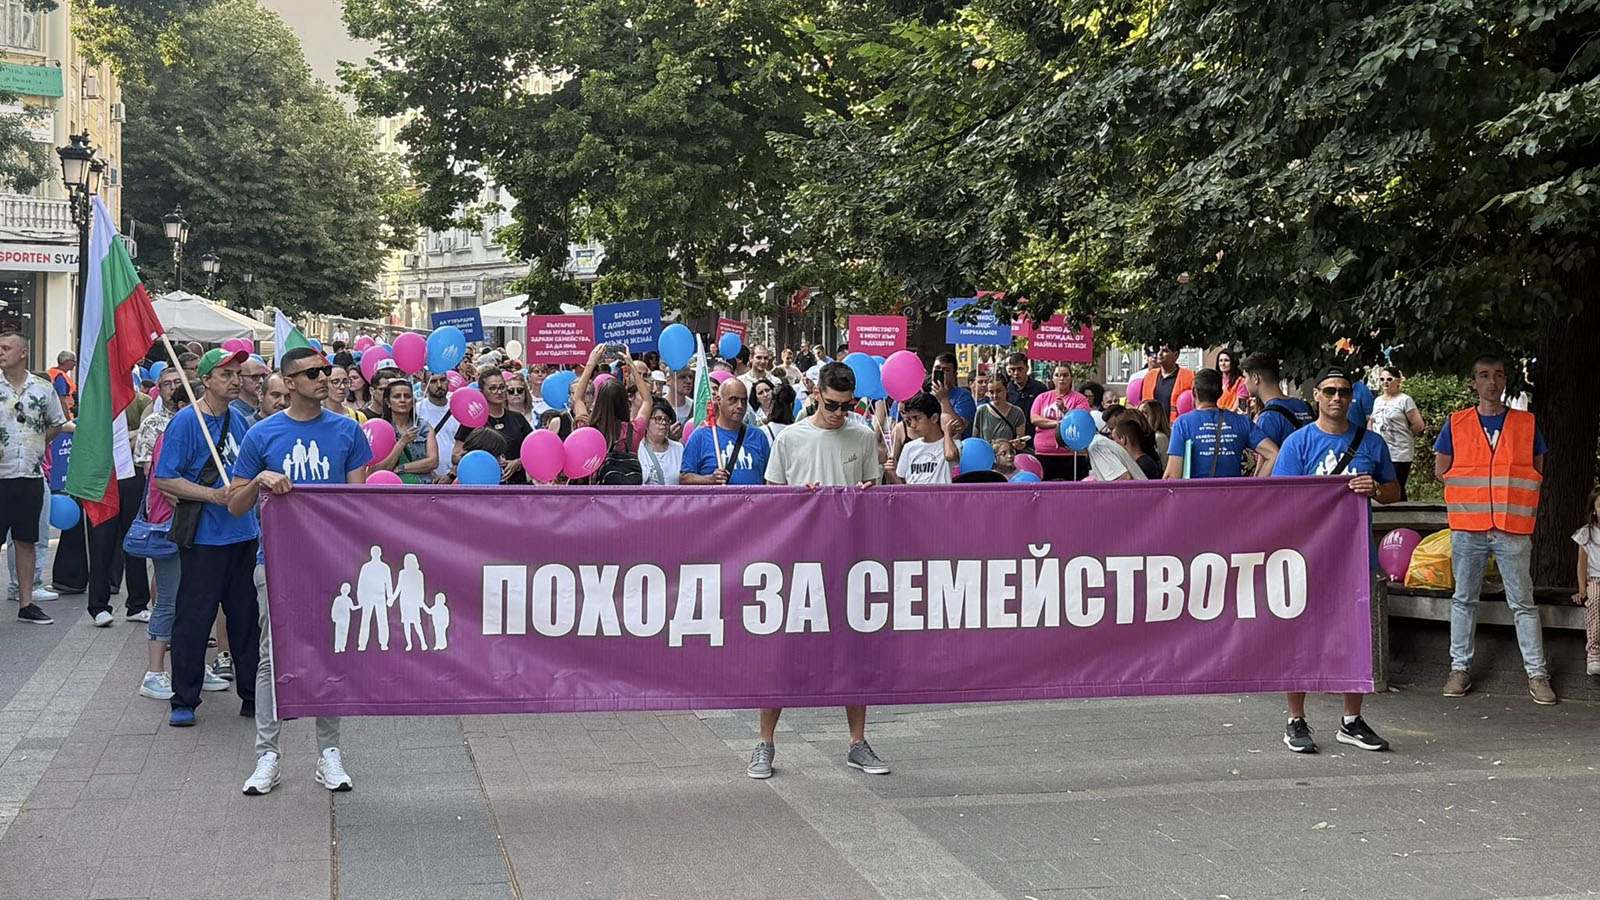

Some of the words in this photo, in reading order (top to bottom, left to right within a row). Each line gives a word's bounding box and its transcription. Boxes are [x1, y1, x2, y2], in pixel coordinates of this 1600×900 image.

[0, 251, 51, 263] SPORTEN
[54, 253, 80, 264] SVIA
[614, 310, 640, 319] БРАКЪТ
[607, 318, 653, 331] ДОБРОВОЛЕН
[604, 330, 625, 339] СЪЮЗ
[626, 327, 652, 336] МЕЖДУ
[1034, 340, 1057, 348] МАЙКА
[481, 563, 725, 647] ПОХОД
[742, 561, 831, 635] ЗА
[846, 542, 1308, 633] СЕМЕЙСТВОТО
